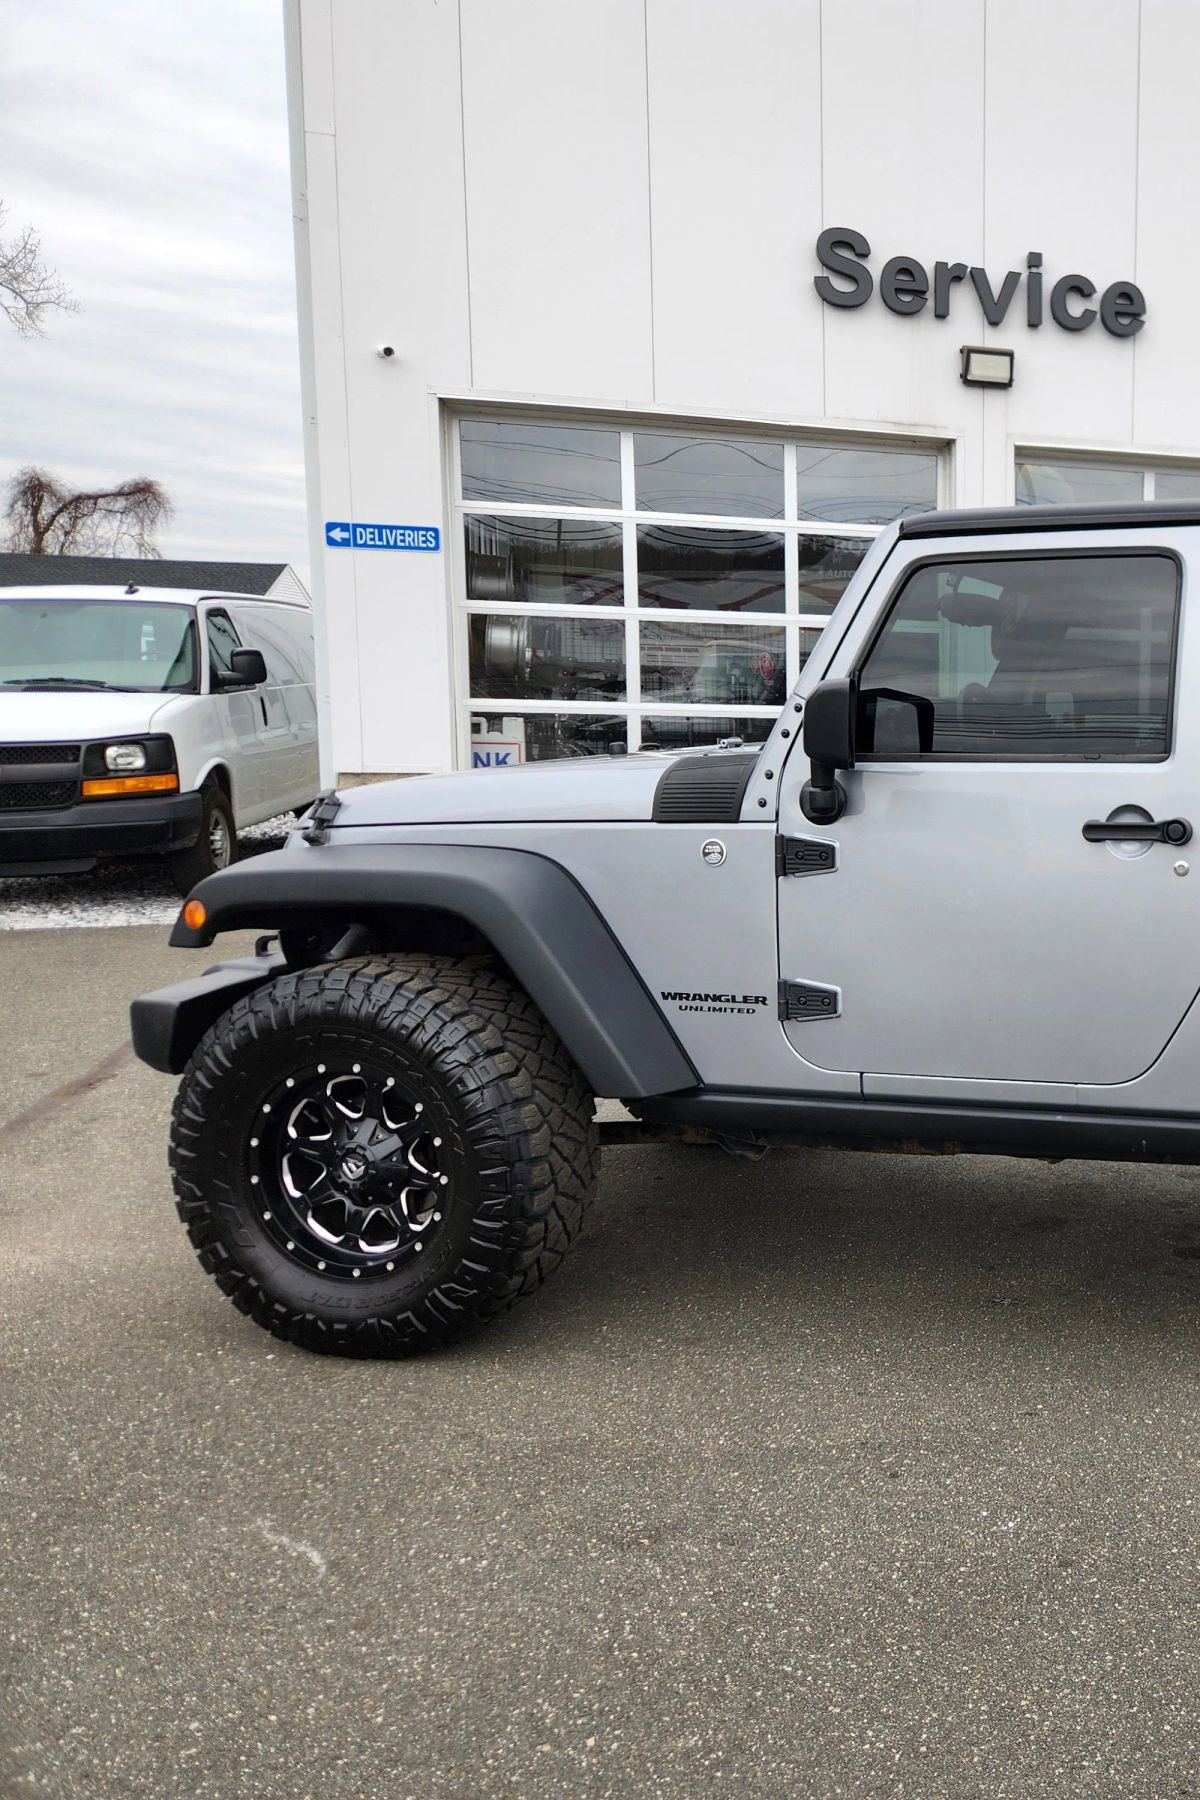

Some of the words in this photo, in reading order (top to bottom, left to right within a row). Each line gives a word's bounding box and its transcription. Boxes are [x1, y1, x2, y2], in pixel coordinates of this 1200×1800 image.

[814, 227, 1146, 337] Service
[356, 527, 436, 548] DELIVERIES
[661, 991, 768, 1005] WRANGLER
[678, 1005, 756, 1014] UNLIMITED
